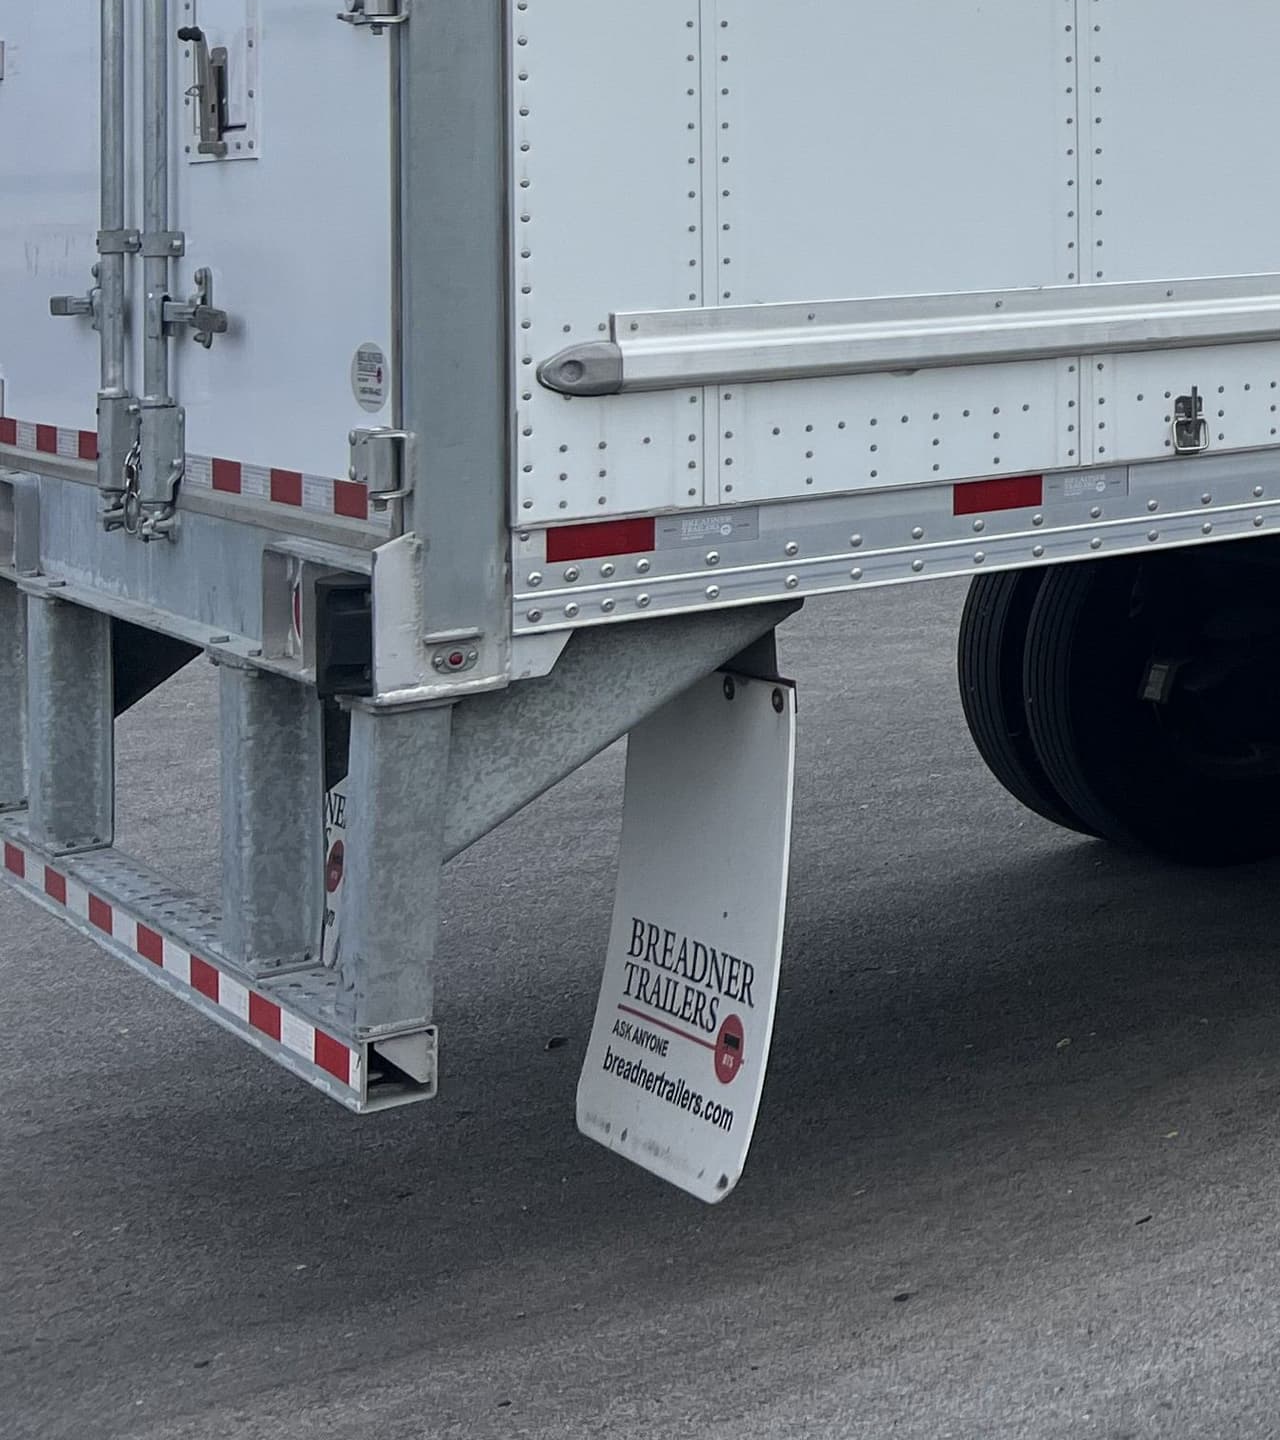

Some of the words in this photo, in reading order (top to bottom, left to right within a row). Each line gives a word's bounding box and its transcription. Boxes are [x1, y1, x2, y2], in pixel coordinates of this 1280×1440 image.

[623, 961, 721, 1033] TRAILERS
[627, 917, 755, 1008] BREADNER
[612, 1019, 632, 1041] ASK
[631, 1024, 669, 1057] ANYONE
[602, 1045, 734, 1132] breadnertrailers.com
